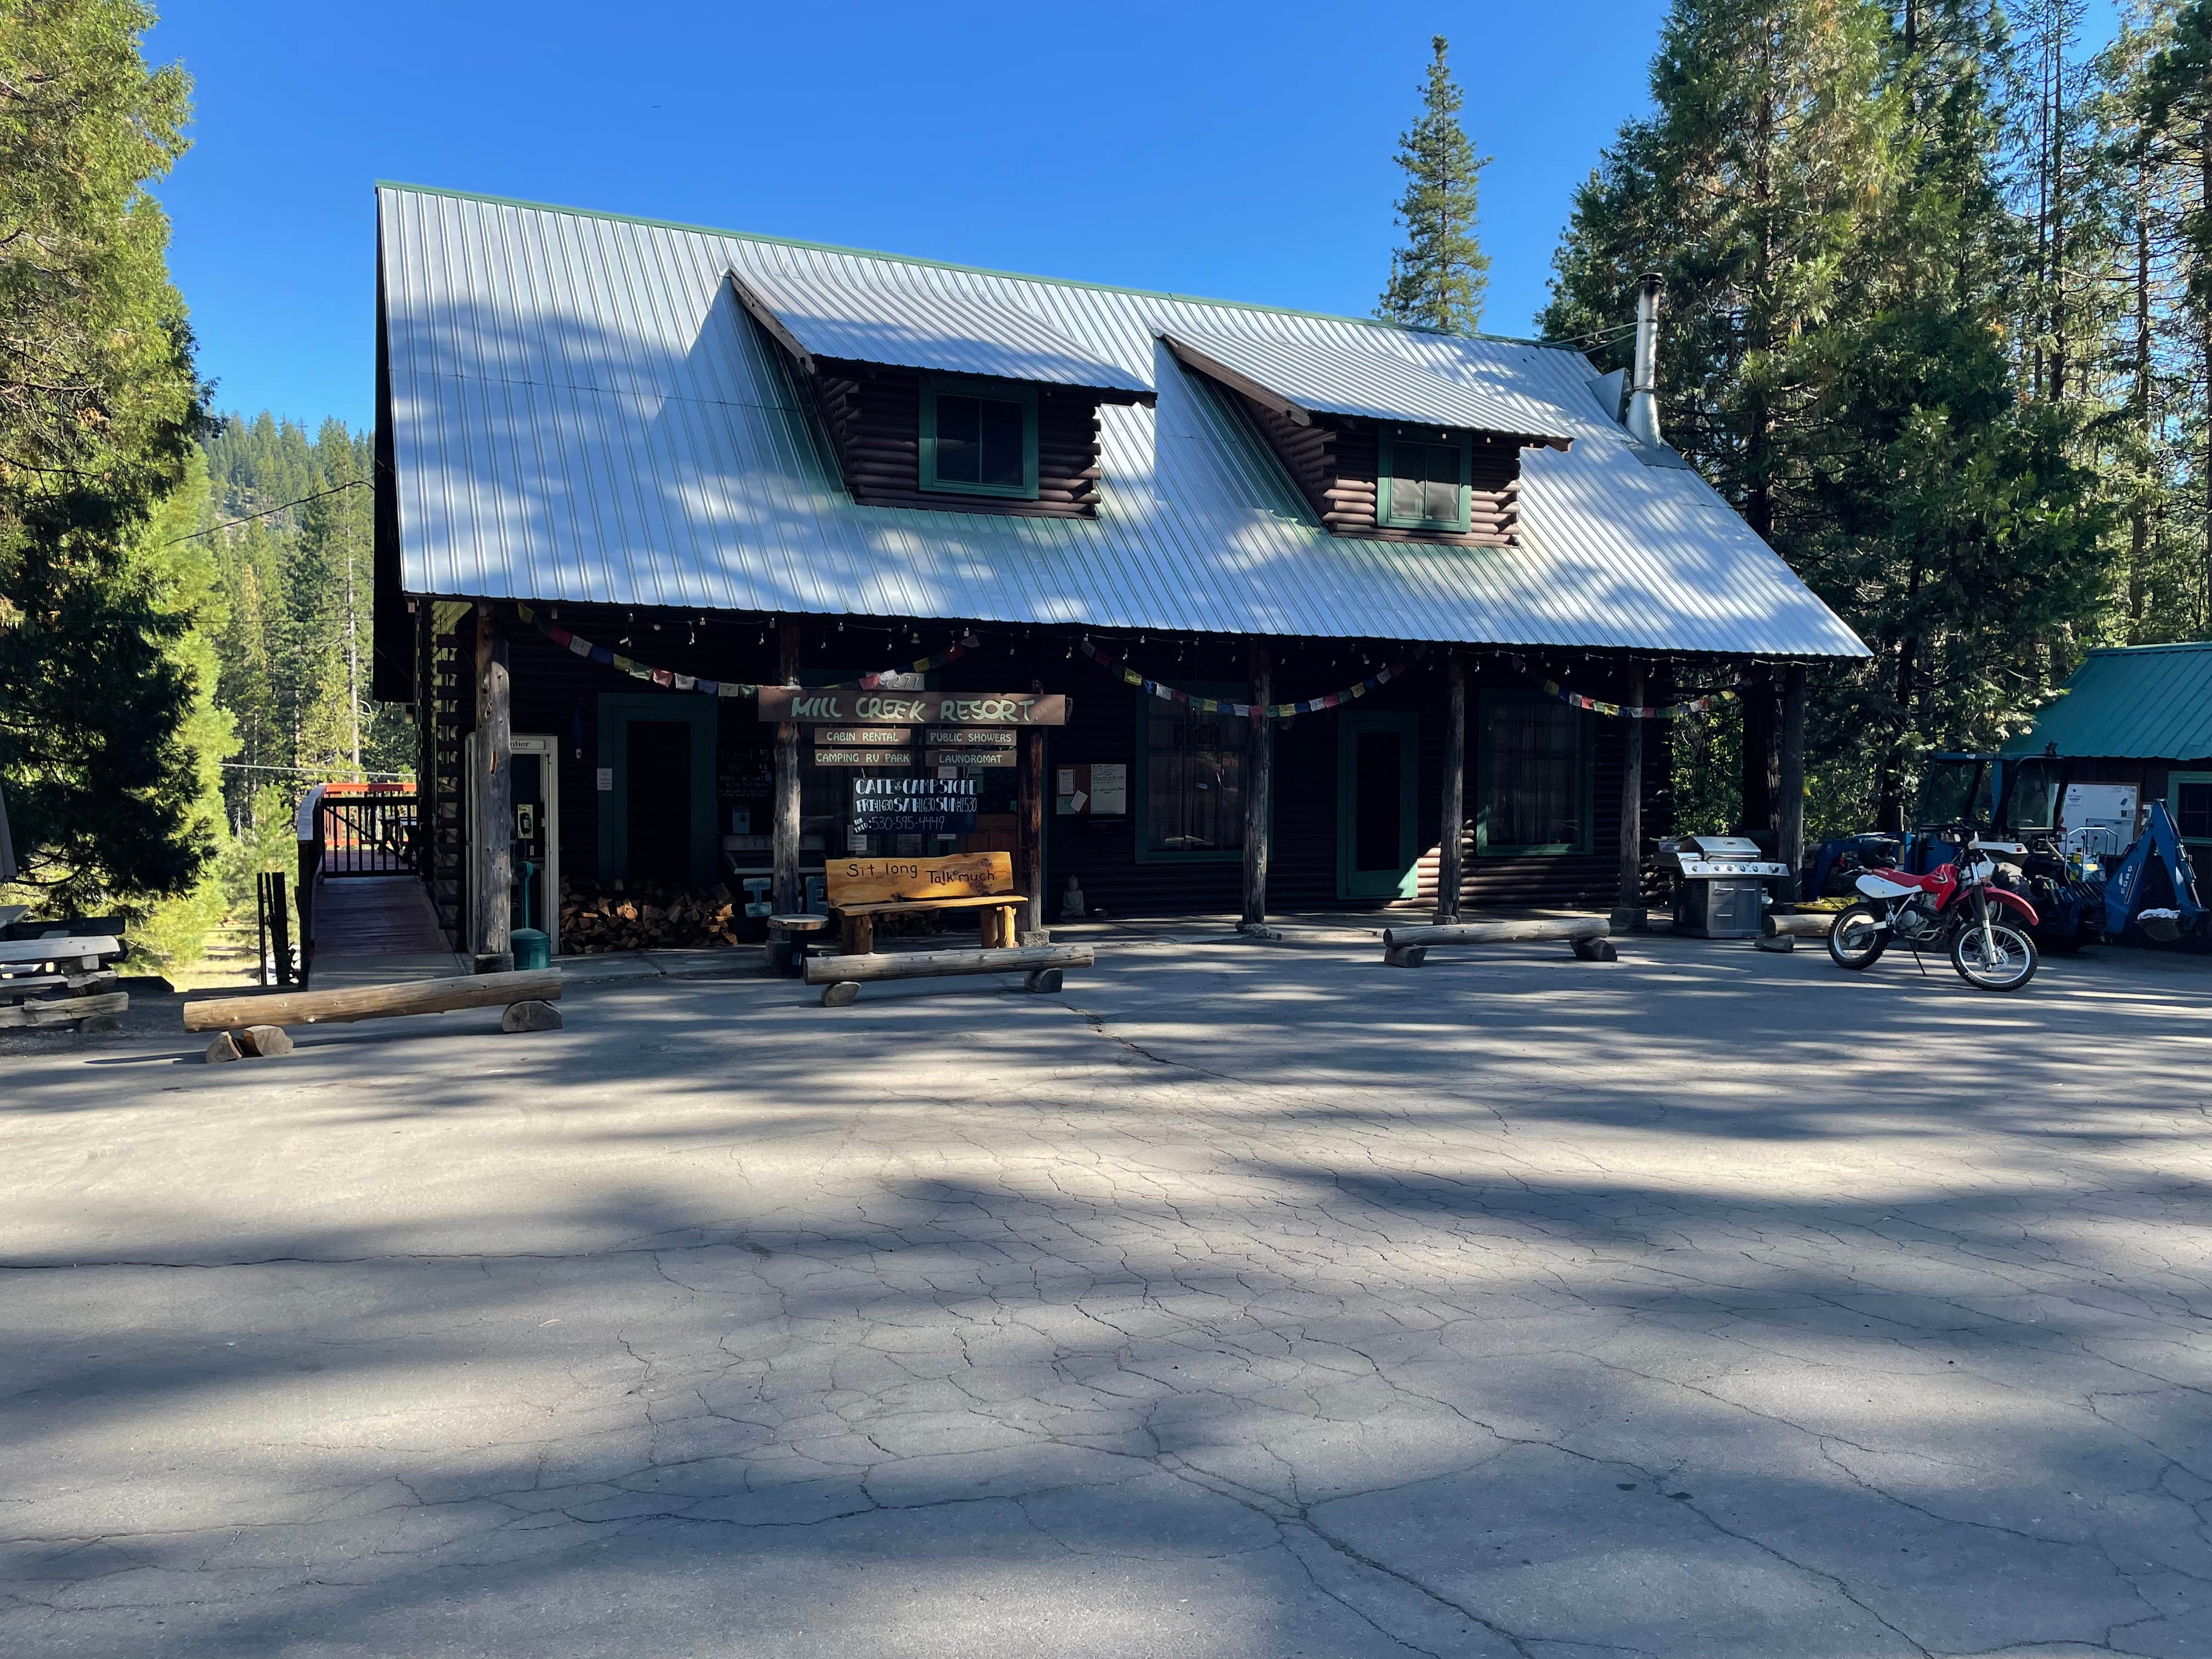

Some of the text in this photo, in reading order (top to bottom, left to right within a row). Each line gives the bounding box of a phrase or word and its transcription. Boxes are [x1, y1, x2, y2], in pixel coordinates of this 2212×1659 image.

[791, 697, 1035, 723] MILL CREEK RESORT
[827, 732, 899, 742] CABIN RENTAL
[930, 732, 1012, 742] PUBLIC SHOWERS
[816, 752, 910, 763] CAMPING RV PARK
[939, 754, 1002, 764] LAUNDROMAT
[855, 779, 895, 794] CAFE
[872, 816, 945, 830] 530-595-4449
[847, 863, 918, 878] Sit long
[926, 869, 995, 884] Talk much
[2121, 865, 2132, 894] FORD
[743, 876, 829, 917] IE
